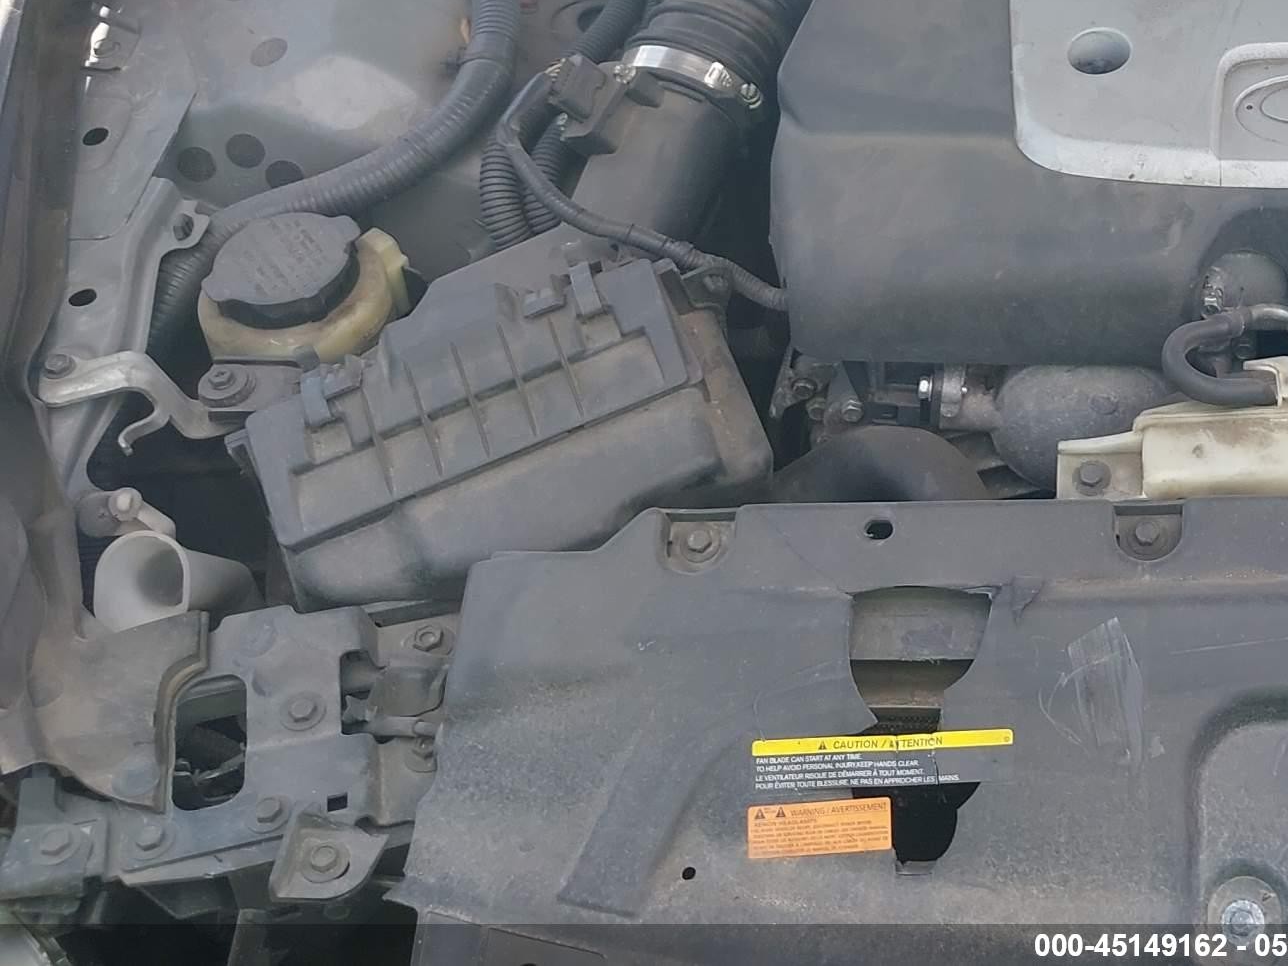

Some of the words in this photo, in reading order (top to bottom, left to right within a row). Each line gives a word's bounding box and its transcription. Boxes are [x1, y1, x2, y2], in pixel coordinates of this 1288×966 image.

[833, 740, 878, 750] CAUTION
[769, 756, 790, 764] BLADE
[782, 764, 801, 772] AVOID
[803, 763, 834, 771] PERSONAL
[764, 772, 804, 781] VENTILATEUR
[804, 771, 828, 779] RISQUE
[878, 769, 895, 777] TOUT
[796, 780, 816, 788] TOUTE
[874, 777, 884, 785] EN
[884, 776, 922, 784] APPROCHER
[923, 775, 936, 783] LES
[790, 807, 825, 817] WARNING
[830, 802, 887, 814] AVERTISSEMENT
